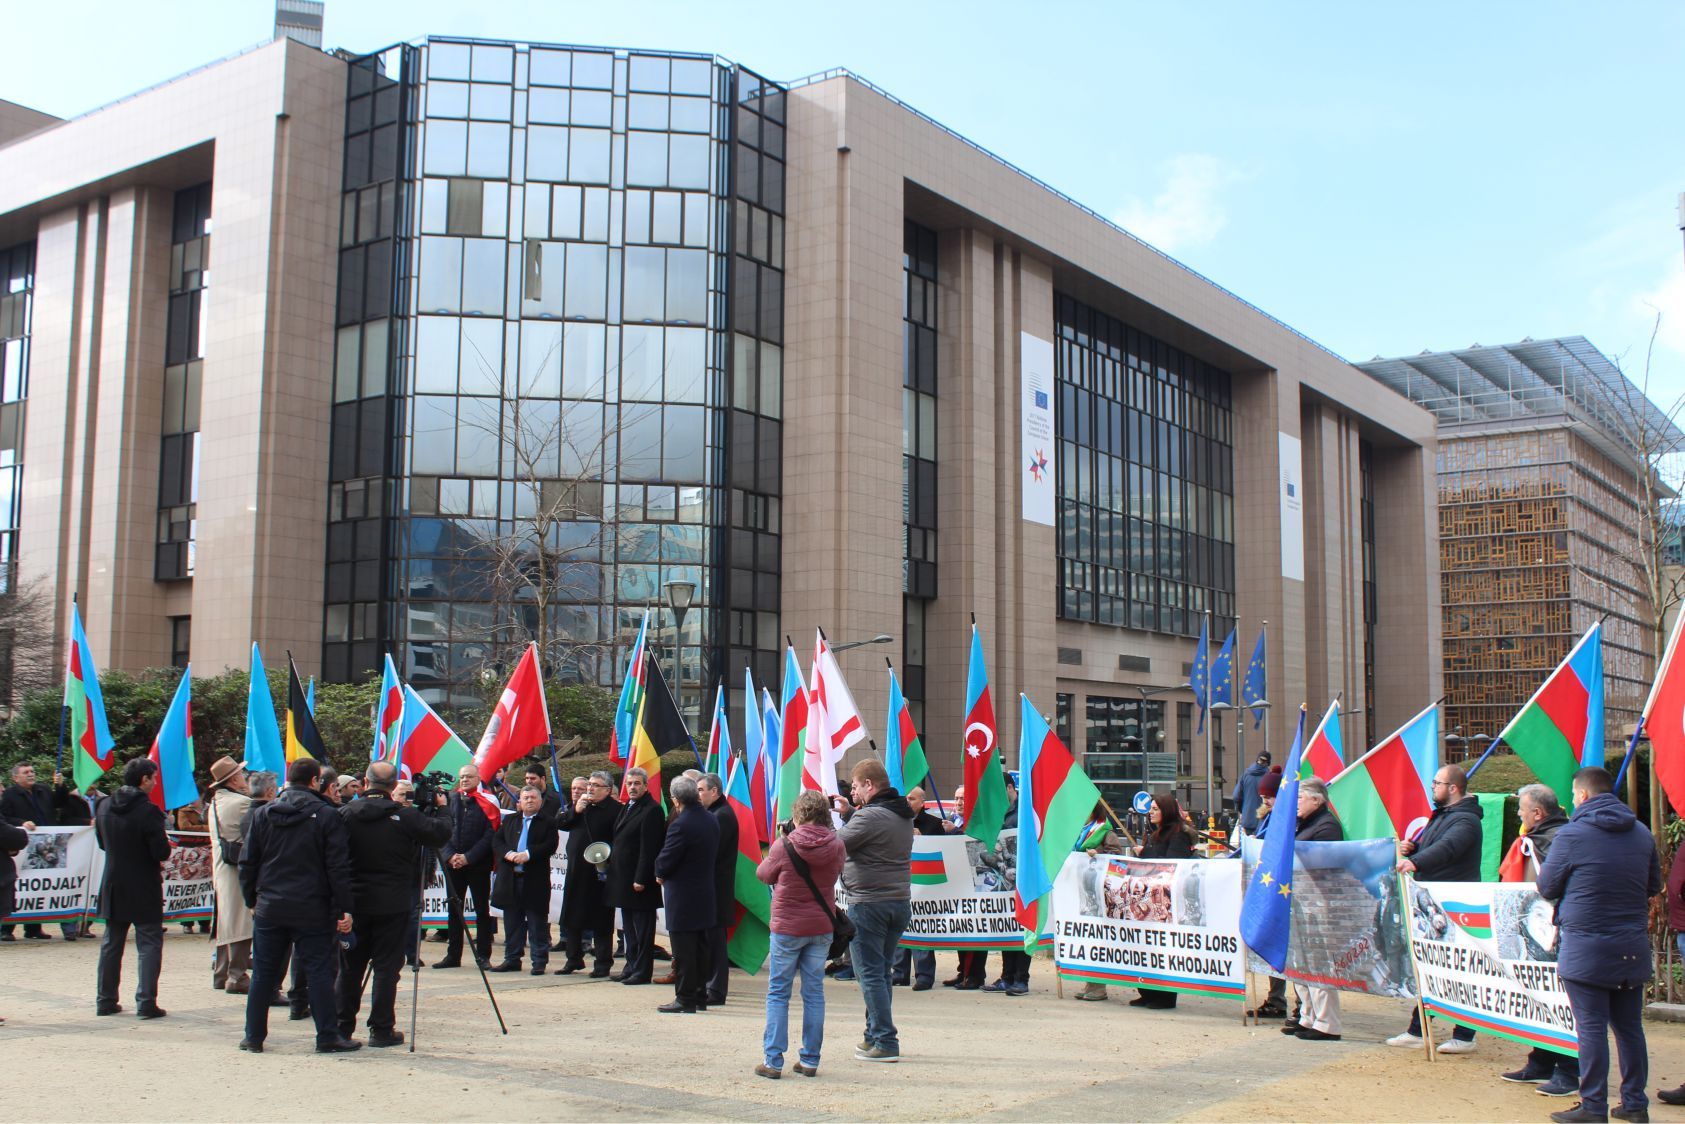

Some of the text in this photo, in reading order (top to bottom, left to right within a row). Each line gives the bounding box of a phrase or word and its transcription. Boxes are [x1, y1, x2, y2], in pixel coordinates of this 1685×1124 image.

[49, 894, 82, 909] NUIT
[166, 884, 198, 897] NEVER
[911, 899, 959, 916] KHODJALY
[962, 898, 978, 914] EST
[980, 897, 1008, 914] CELUI
[950, 918, 974, 934] DANS
[976, 918, 988, 933] LE
[1064, 921, 1118, 942] ENFANTS
[1119, 926, 1142, 944] ONT
[1144, 929, 1166, 947] ETE
[1170, 931, 1202, 950] TUES
[1204, 934, 1238, 954] LORS
[1068, 944, 1086, 960] LA
[1089, 946, 1147, 967] GENOCIDE
[1150, 955, 1166, 970] DE
[1168, 955, 1233, 977] KHODJALY
[1453, 947, 1467, 972] DE
[1480, 986, 1493, 1011] LE
[1494, 989, 1506, 1014] 26
[1551, 1003, 1575, 1032] 199
